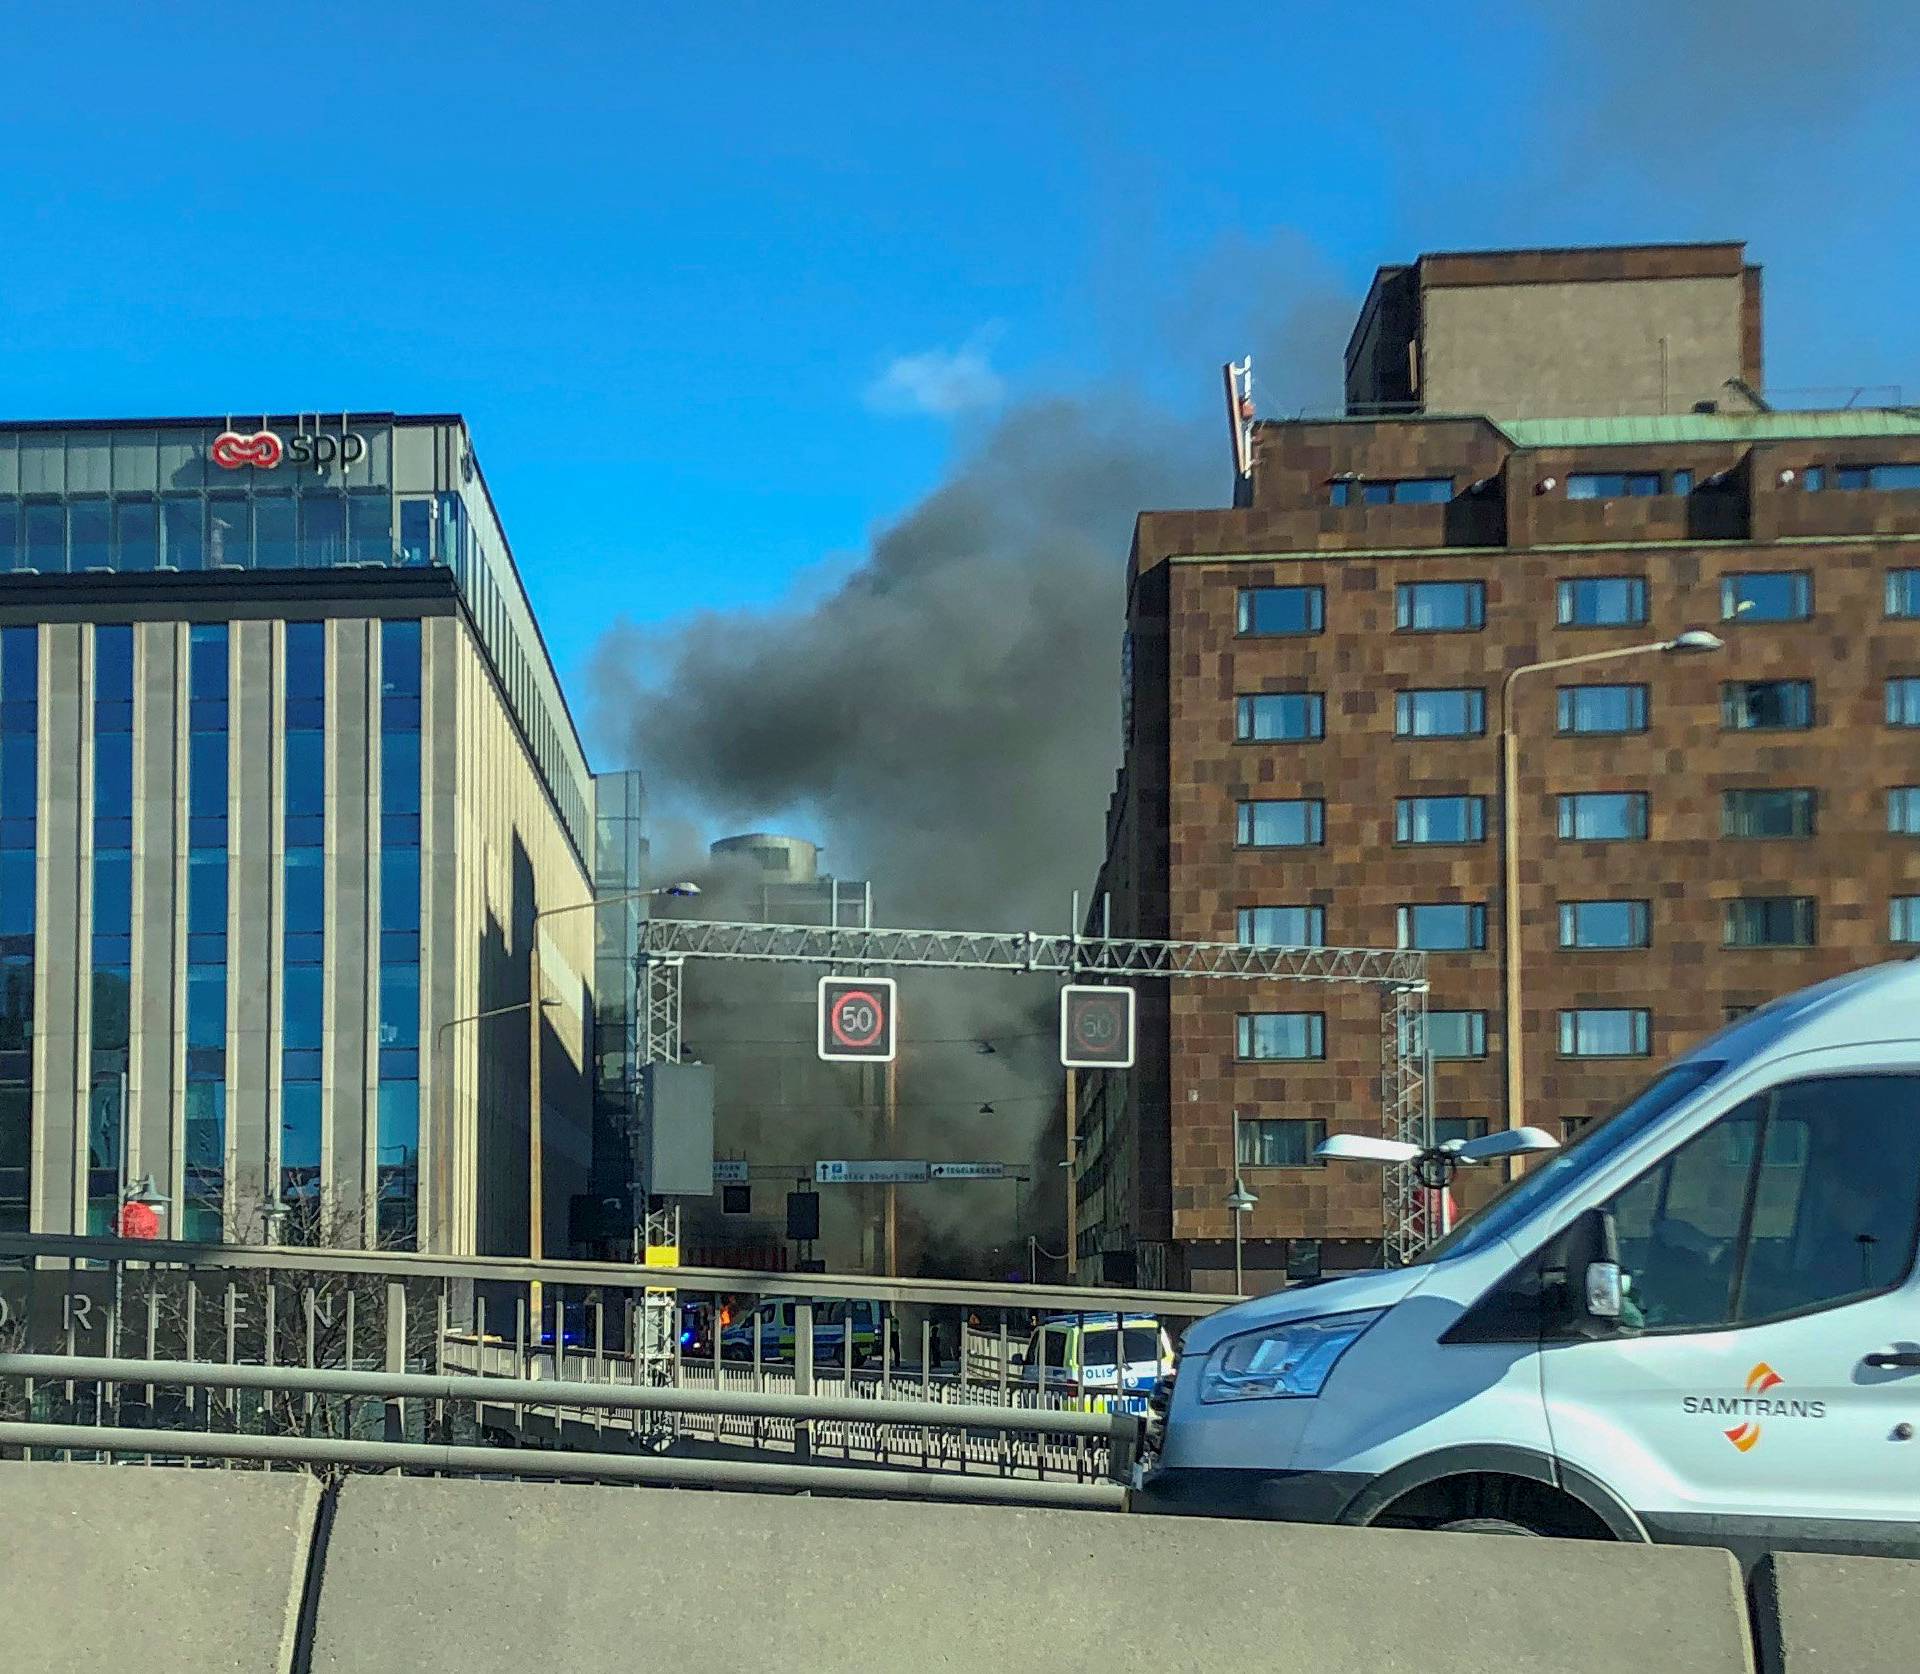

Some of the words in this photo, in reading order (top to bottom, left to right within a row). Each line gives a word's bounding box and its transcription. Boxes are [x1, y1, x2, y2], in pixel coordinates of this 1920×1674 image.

[289, 433, 366, 474] spp
[842, 1006, 873, 1032] 50
[1083, 1013, 1112, 1038] 50
[1081, 1367, 1113, 1379] OLIS
[1683, 1396, 1826, 1418] SAMTRANS
